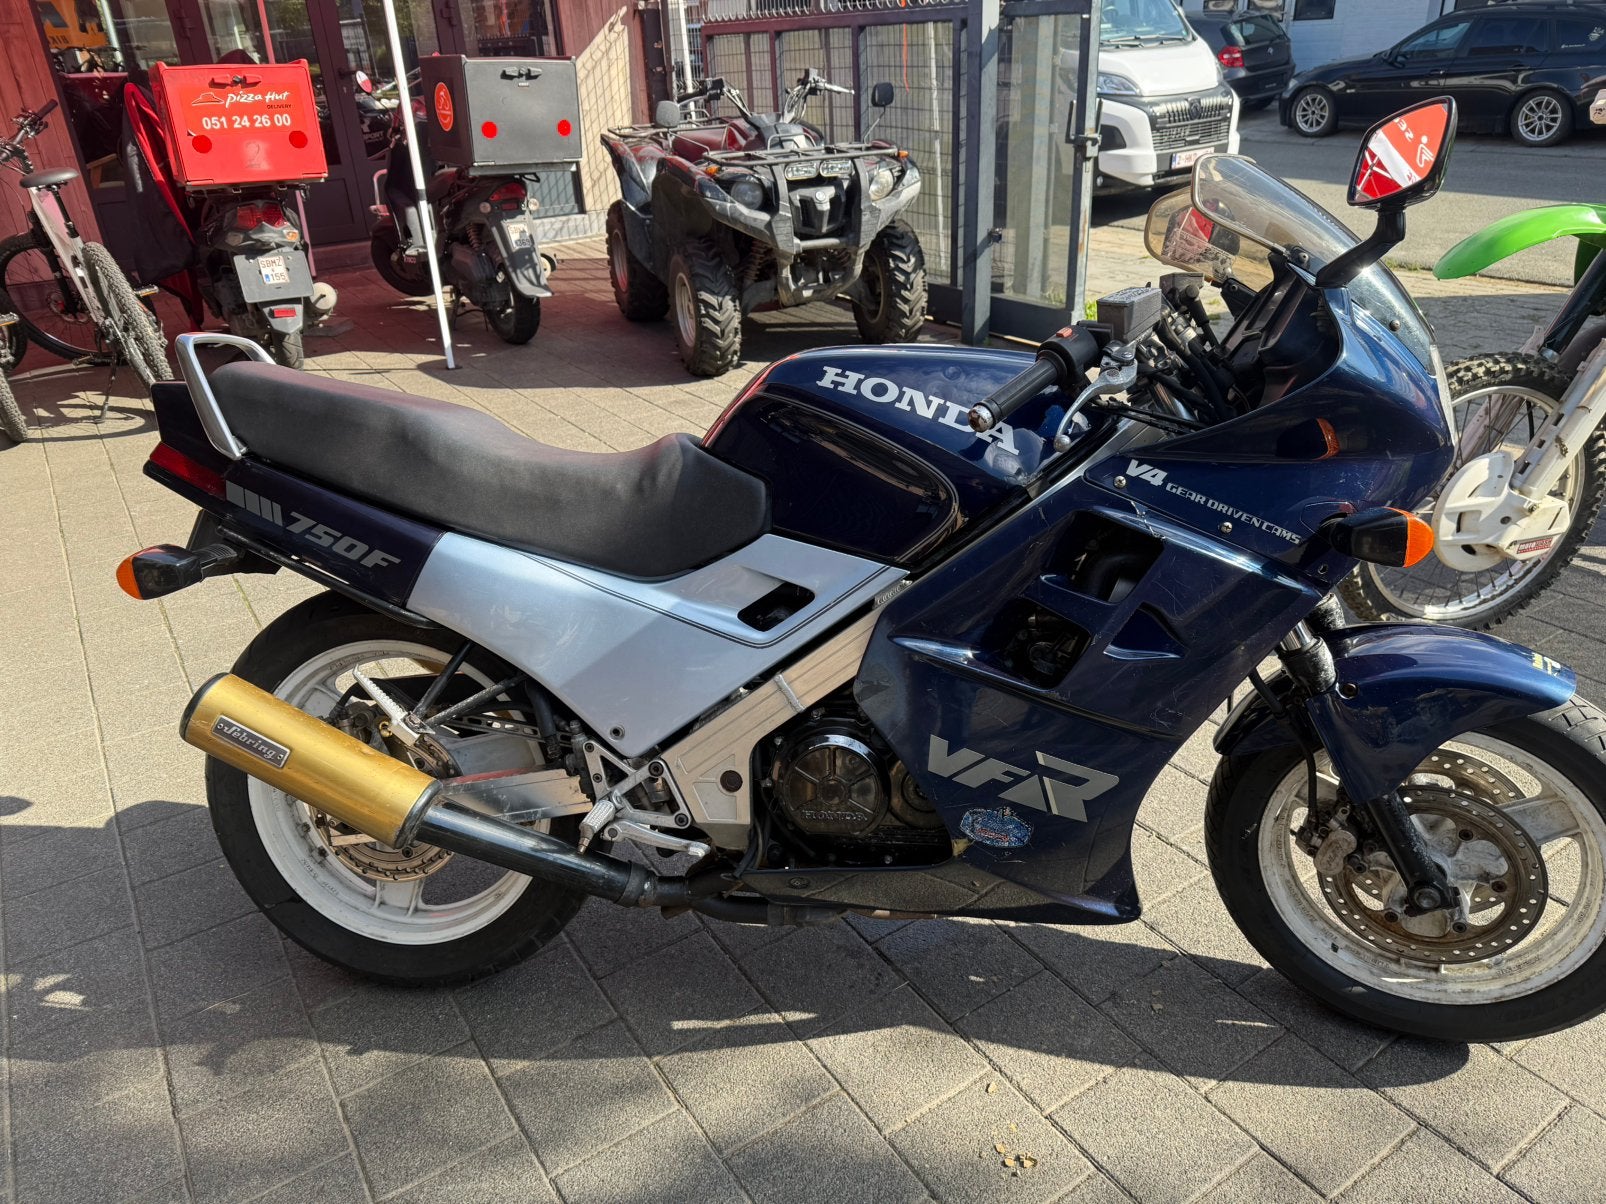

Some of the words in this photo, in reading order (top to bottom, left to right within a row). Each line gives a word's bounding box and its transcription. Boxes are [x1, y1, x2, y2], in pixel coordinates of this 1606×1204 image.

[202, 116, 228, 129] 051
[232, 115, 250, 128] 24
[253, 114, 271, 127] 26
[274, 113, 291, 126] 00
[265, 91, 290, 103] Hut
[815, 365, 1020, 456] HONDA
[1125, 459, 1169, 487] V4
[1165, 482, 1207, 506] GEAR
[1206, 499, 1261, 528] DRIVEN
[1262, 521, 1302, 546] CAMS
[285, 511, 402, 569] 750F
[222, 726, 277, 760] Sebring
[927, 734, 1120, 823] VFR
